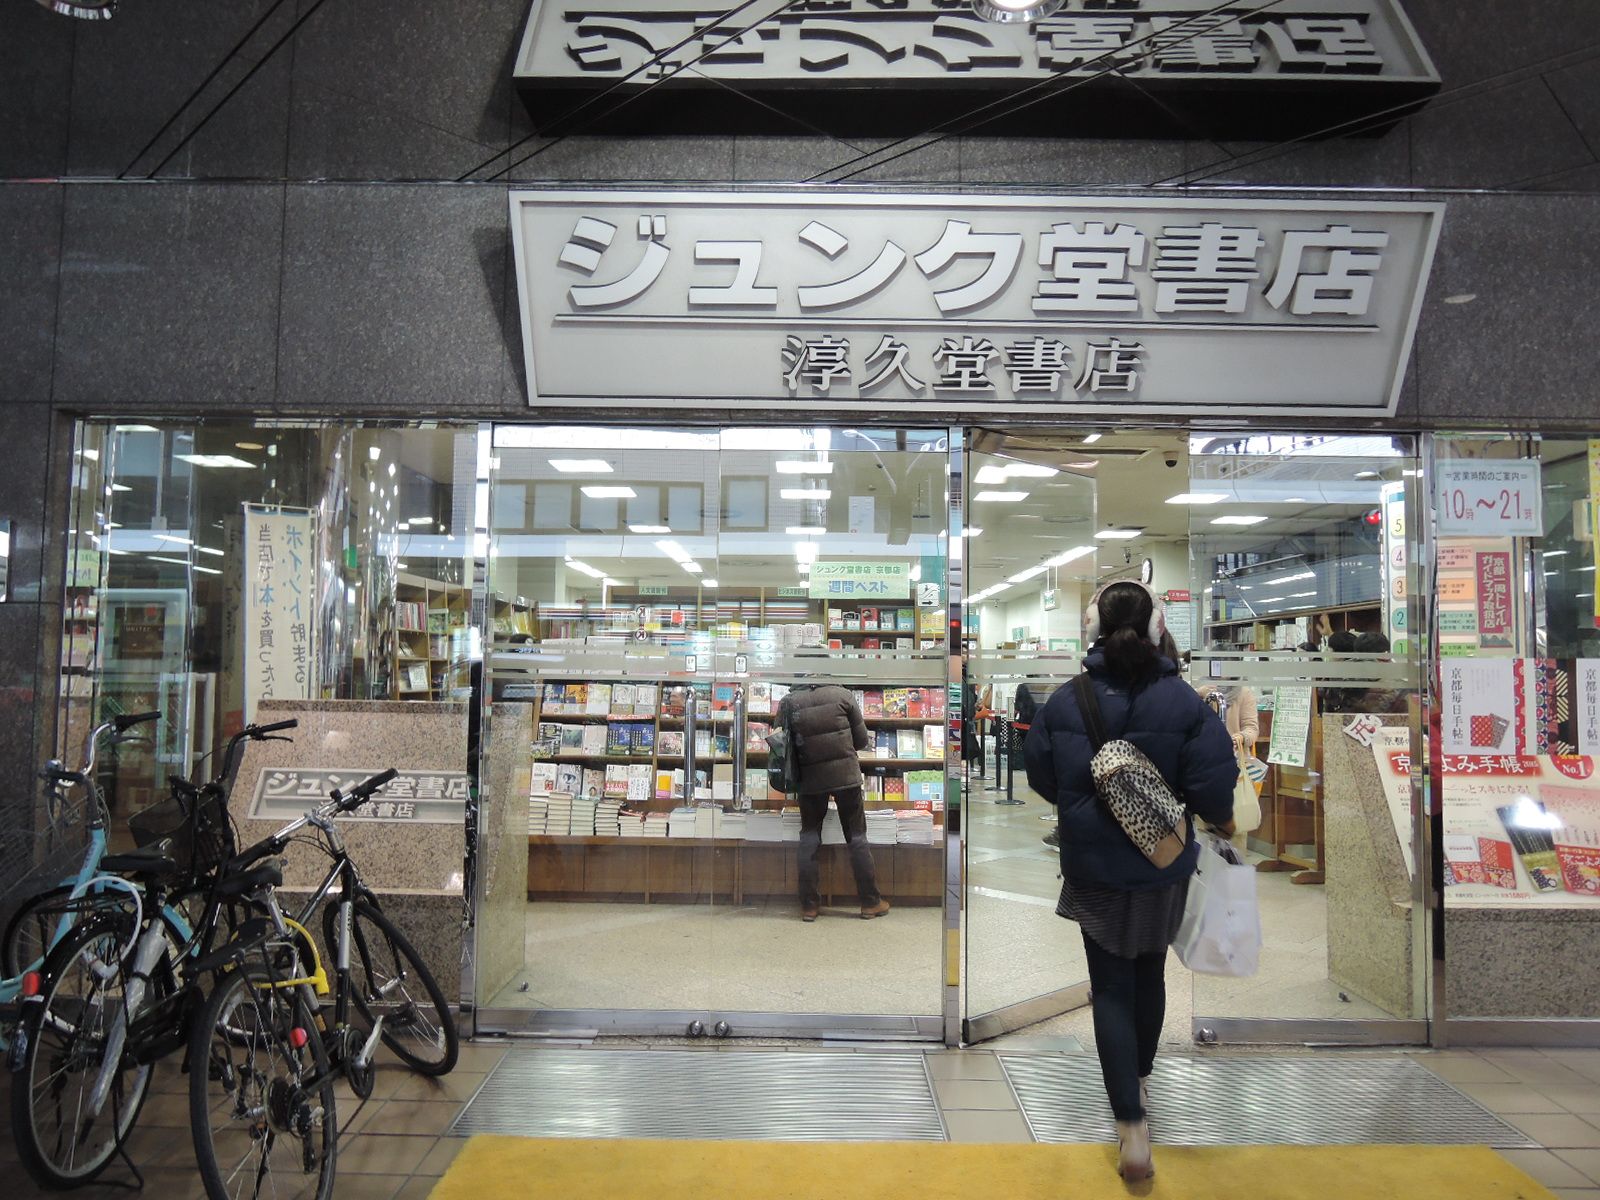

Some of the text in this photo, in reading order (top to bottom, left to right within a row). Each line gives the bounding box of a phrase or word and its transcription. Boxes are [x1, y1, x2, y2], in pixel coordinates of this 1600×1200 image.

[556, 214, 1389, 317] ジュンク堂書店
[781, 333, 1146, 396] 淳久堂書店
[1395, 518, 1403, 533] 5
[1395, 549, 1403, 563] 4
[828, 580, 889, 594] 週間ベスト
[1396, 580, 1404, 594] 3
[1396, 611, 1405, 625] 2
